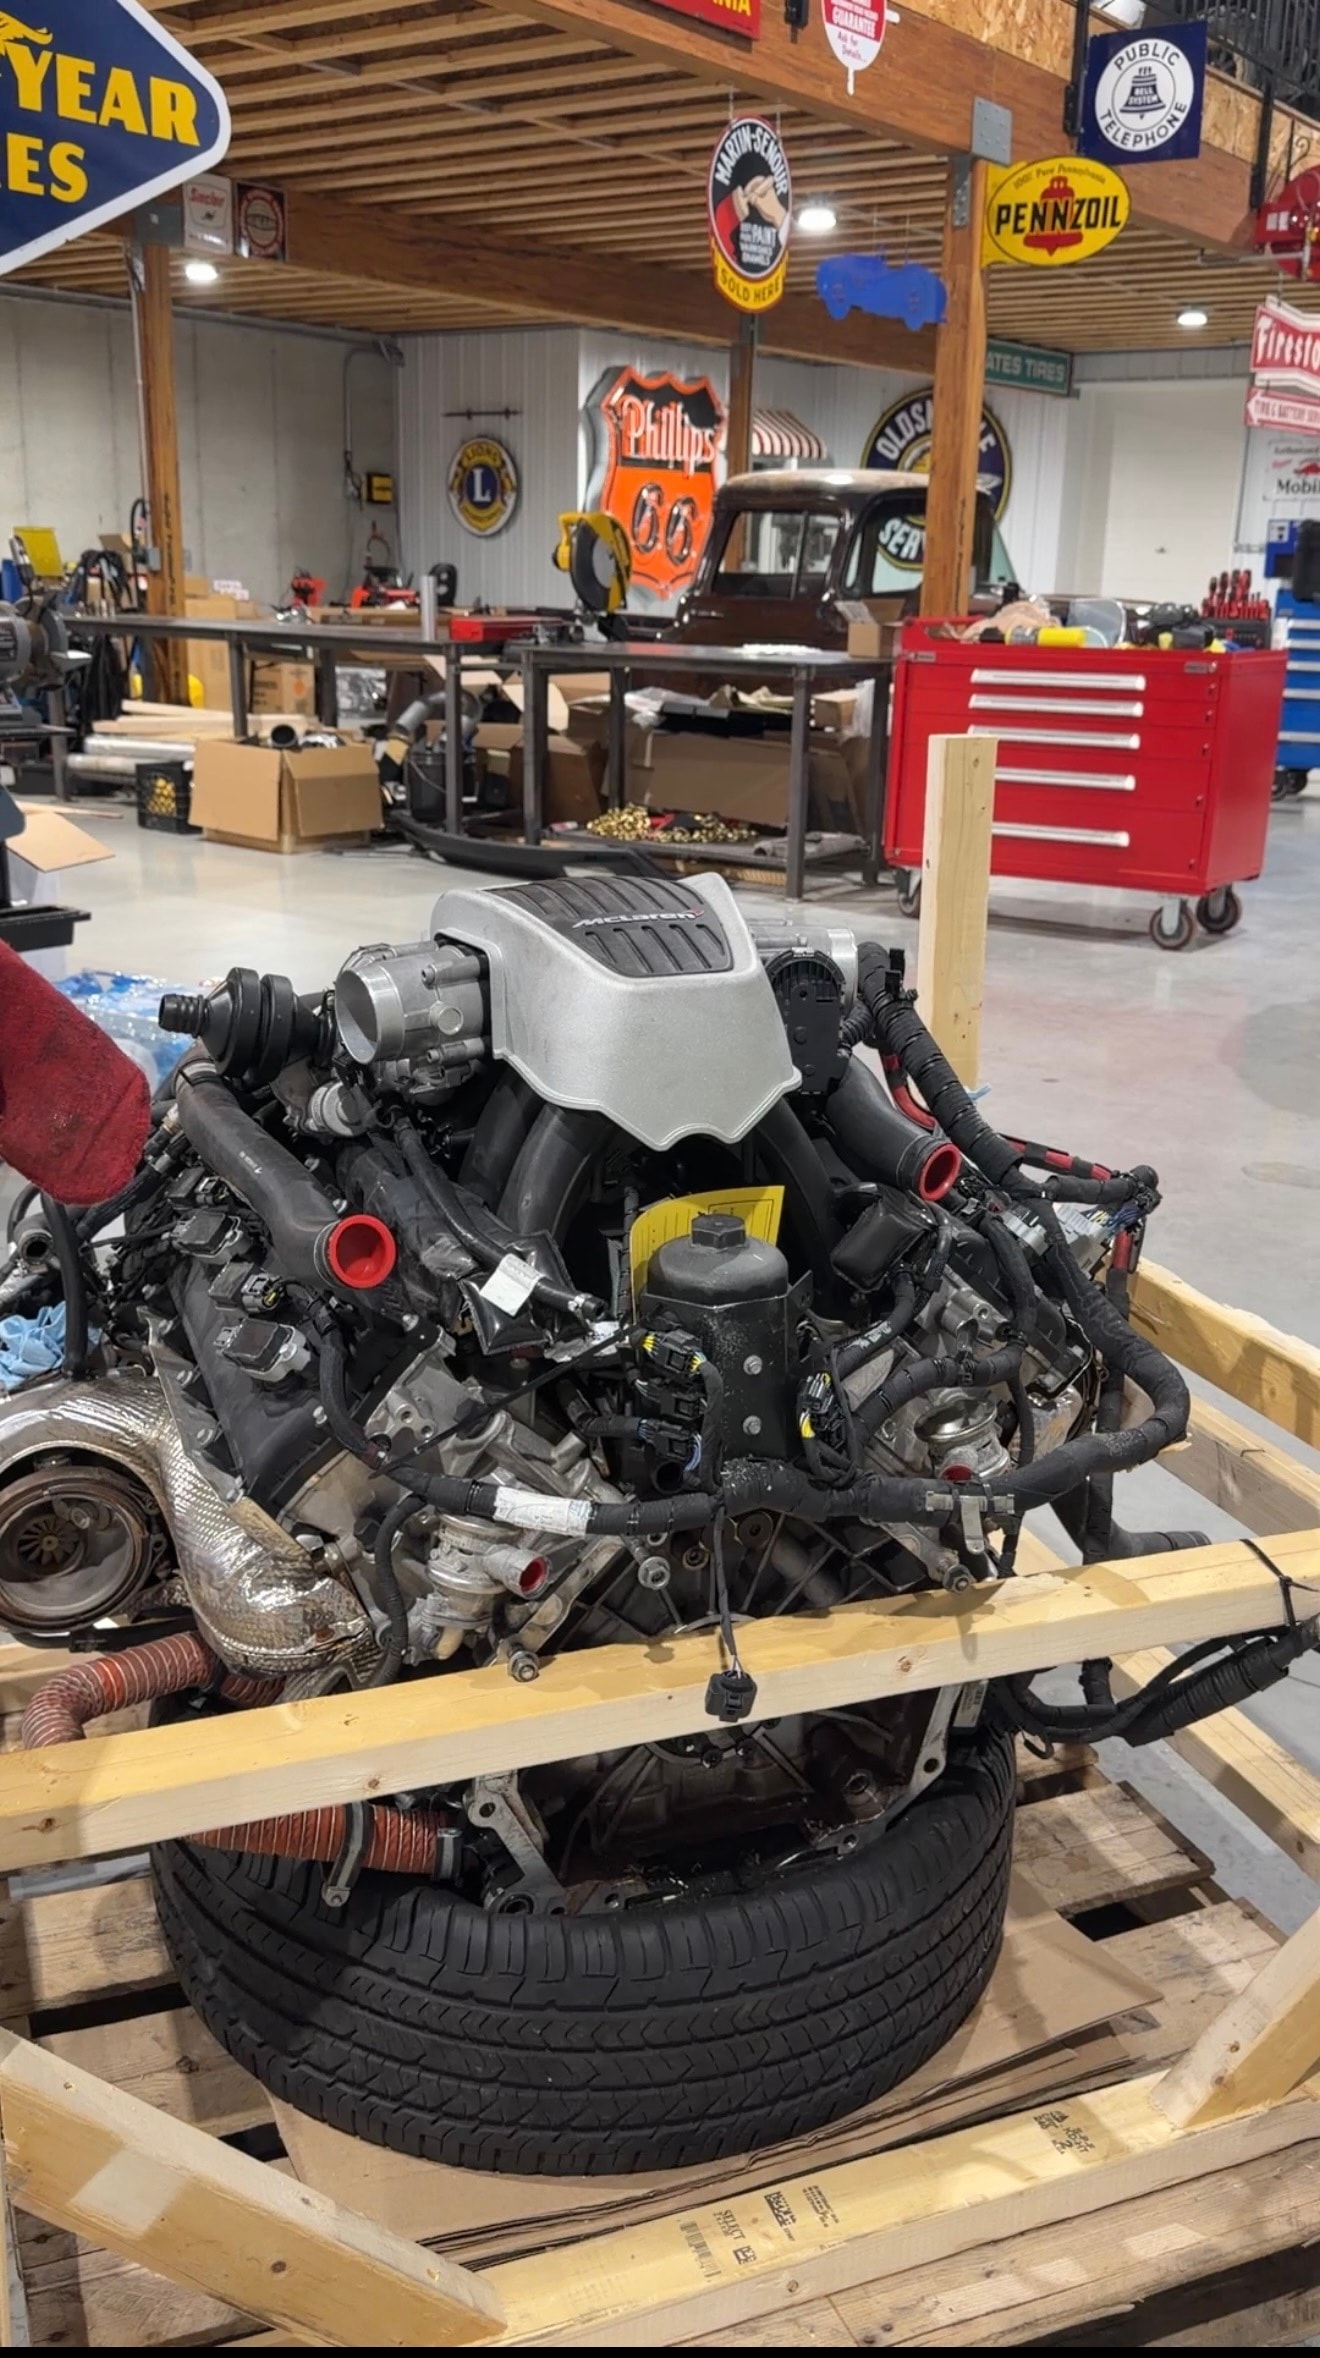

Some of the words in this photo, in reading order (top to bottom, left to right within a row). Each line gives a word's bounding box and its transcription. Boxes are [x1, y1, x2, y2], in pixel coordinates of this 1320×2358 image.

[1114, 42, 1180, 71] PUBLIC
[5, 42, 200, 147] YEAR
[1134, 86, 1153, 96] BELL
[1101, 102, 1188, 148] TELEPHONE
[6, 132, 88, 203] ES
[995, 196, 1122, 236] PENNZOIL
[720, 269, 750, 301] SOLD
[753, 278, 780, 302] HERE
[1024, 357, 1065, 382] TIRES
[621, 394, 717, 479] Phillips
[472, 468, 491, 502] L
[631, 482, 698, 566] 66
[879, 517, 925, 560] SER
[572, 912, 700, 928] McLaren
[722, 2209, 747, 2240] SELECT
